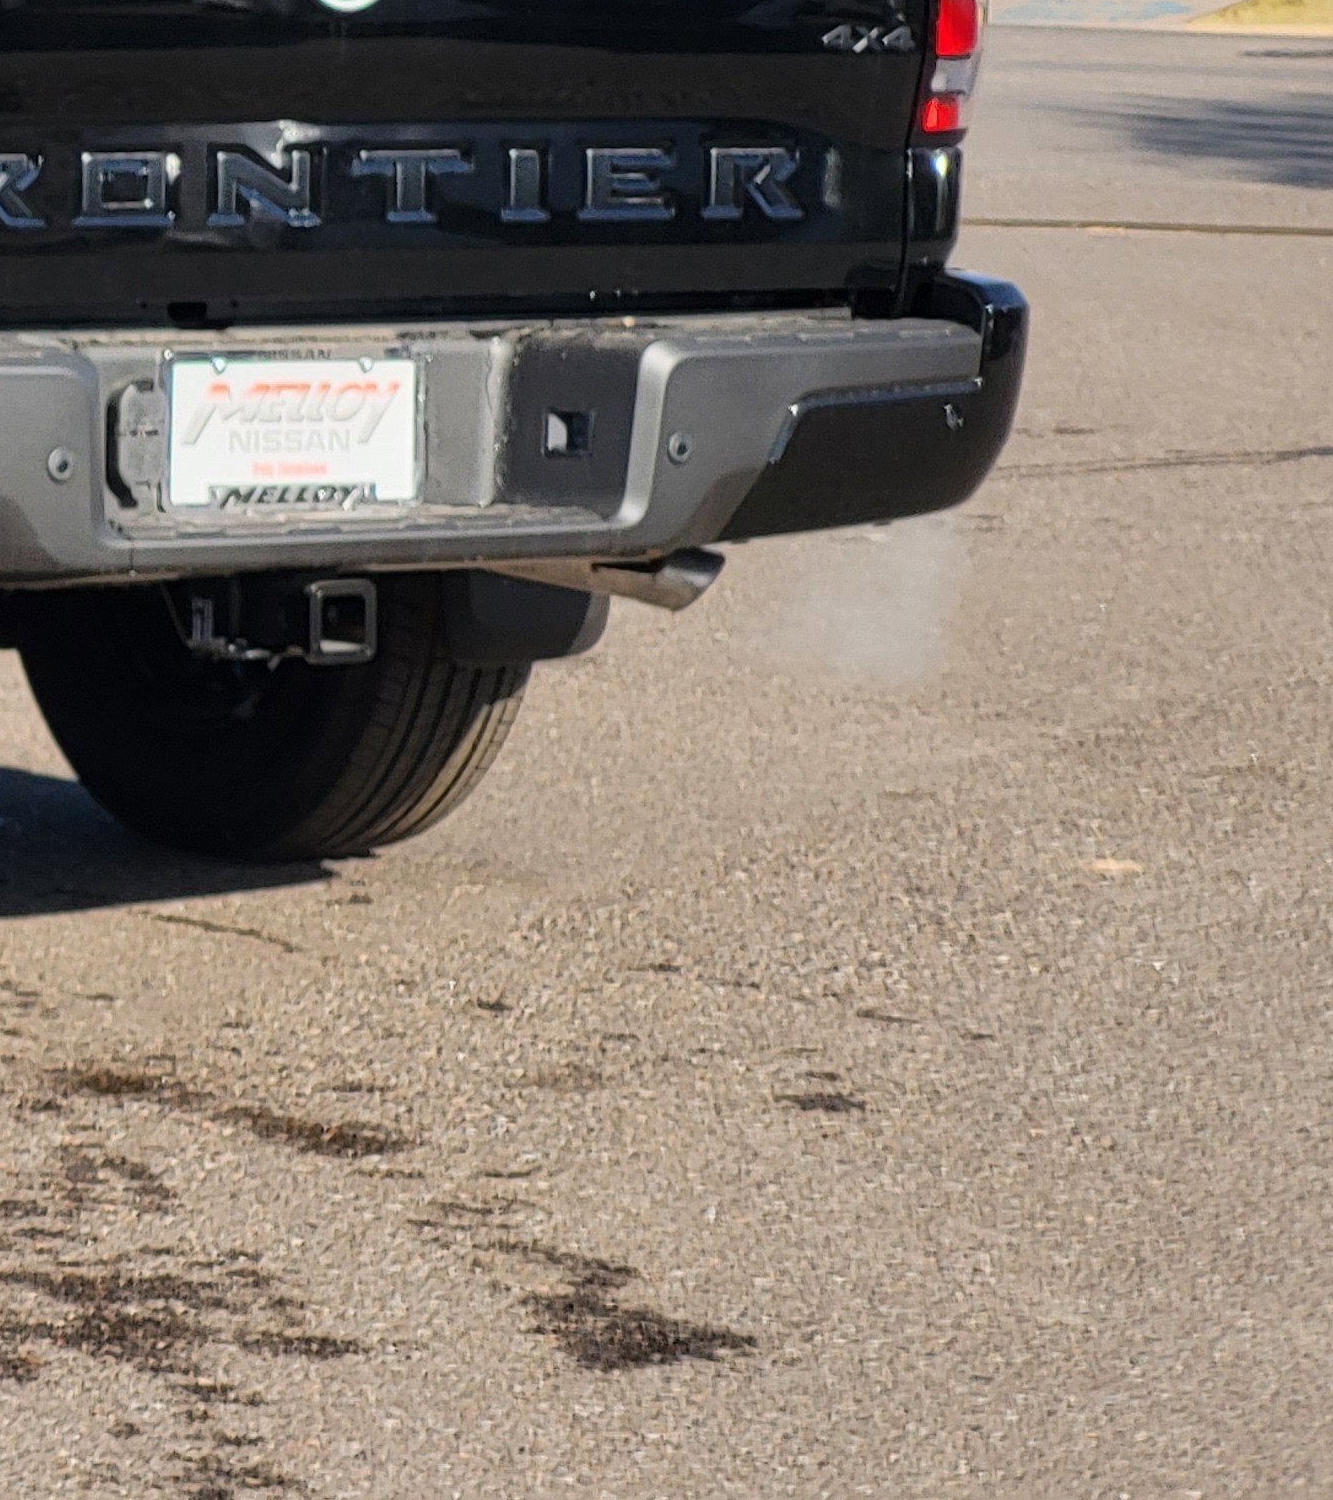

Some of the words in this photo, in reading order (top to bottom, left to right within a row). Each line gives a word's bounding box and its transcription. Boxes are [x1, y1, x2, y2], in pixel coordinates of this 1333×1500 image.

[183, 380, 401, 446] MELLOY
[229, 428, 350, 454] NISSAN
[220, 484, 359, 510] MELLOY
